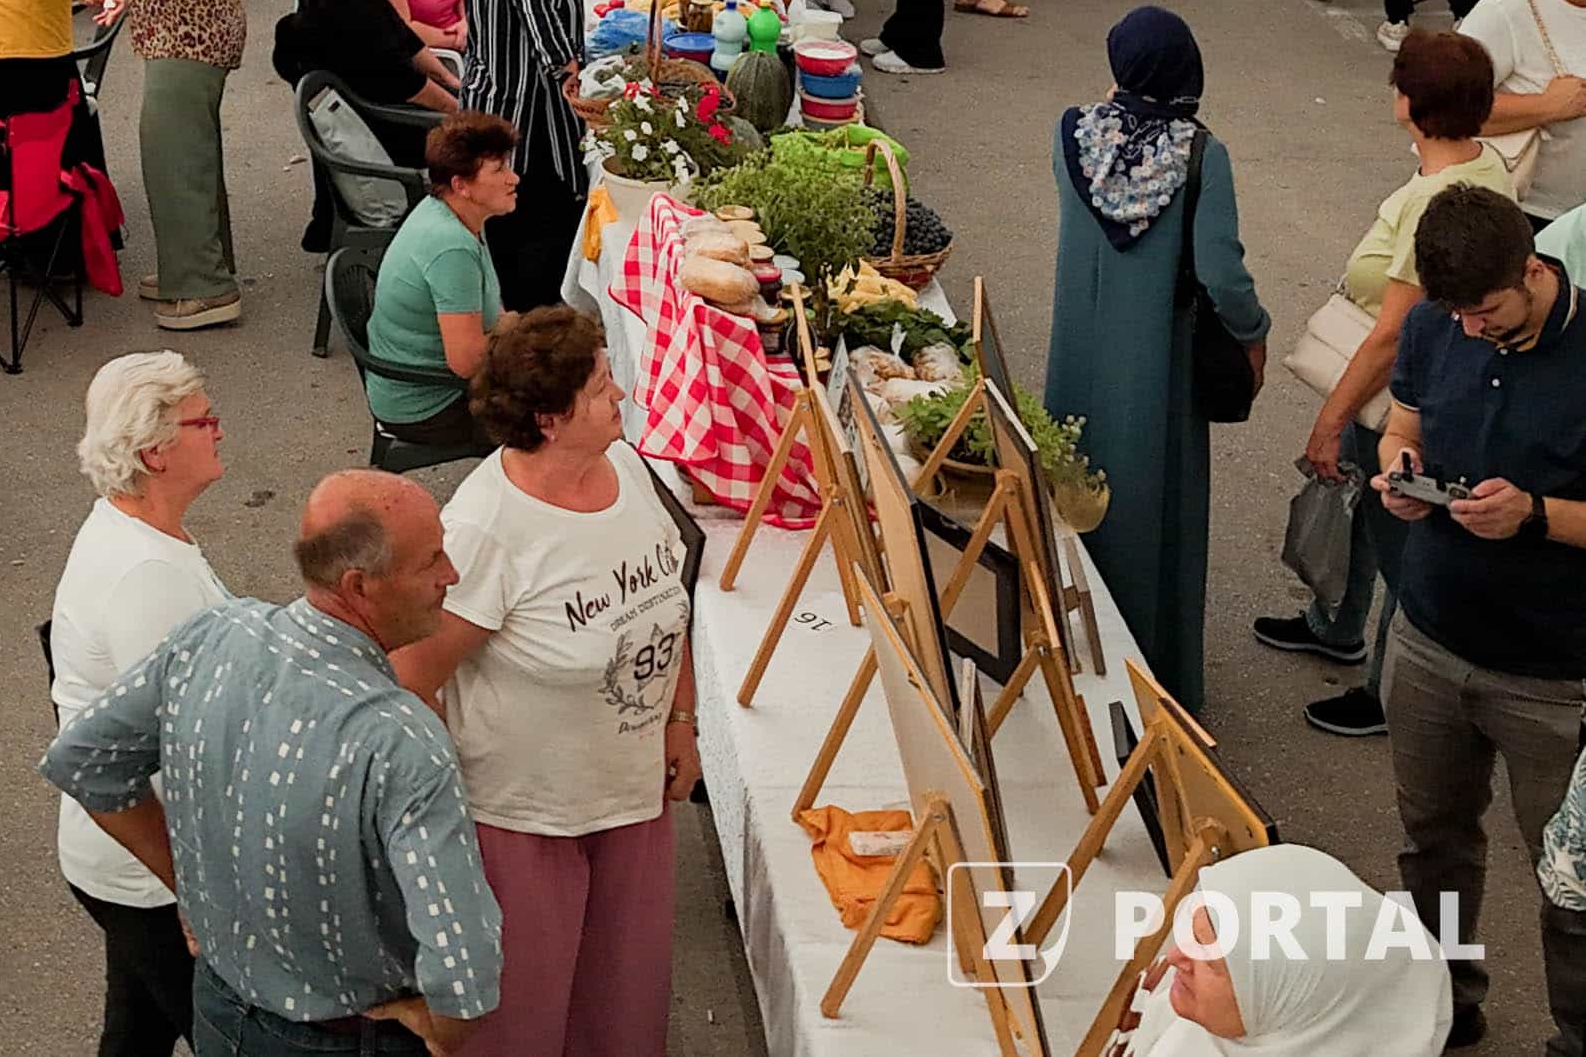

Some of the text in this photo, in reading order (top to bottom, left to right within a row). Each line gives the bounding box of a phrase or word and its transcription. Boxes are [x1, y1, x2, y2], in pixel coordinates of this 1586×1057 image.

[565, 590, 611, 632] New
[613, 555, 658, 605] York
[634, 632, 677, 680] 93
